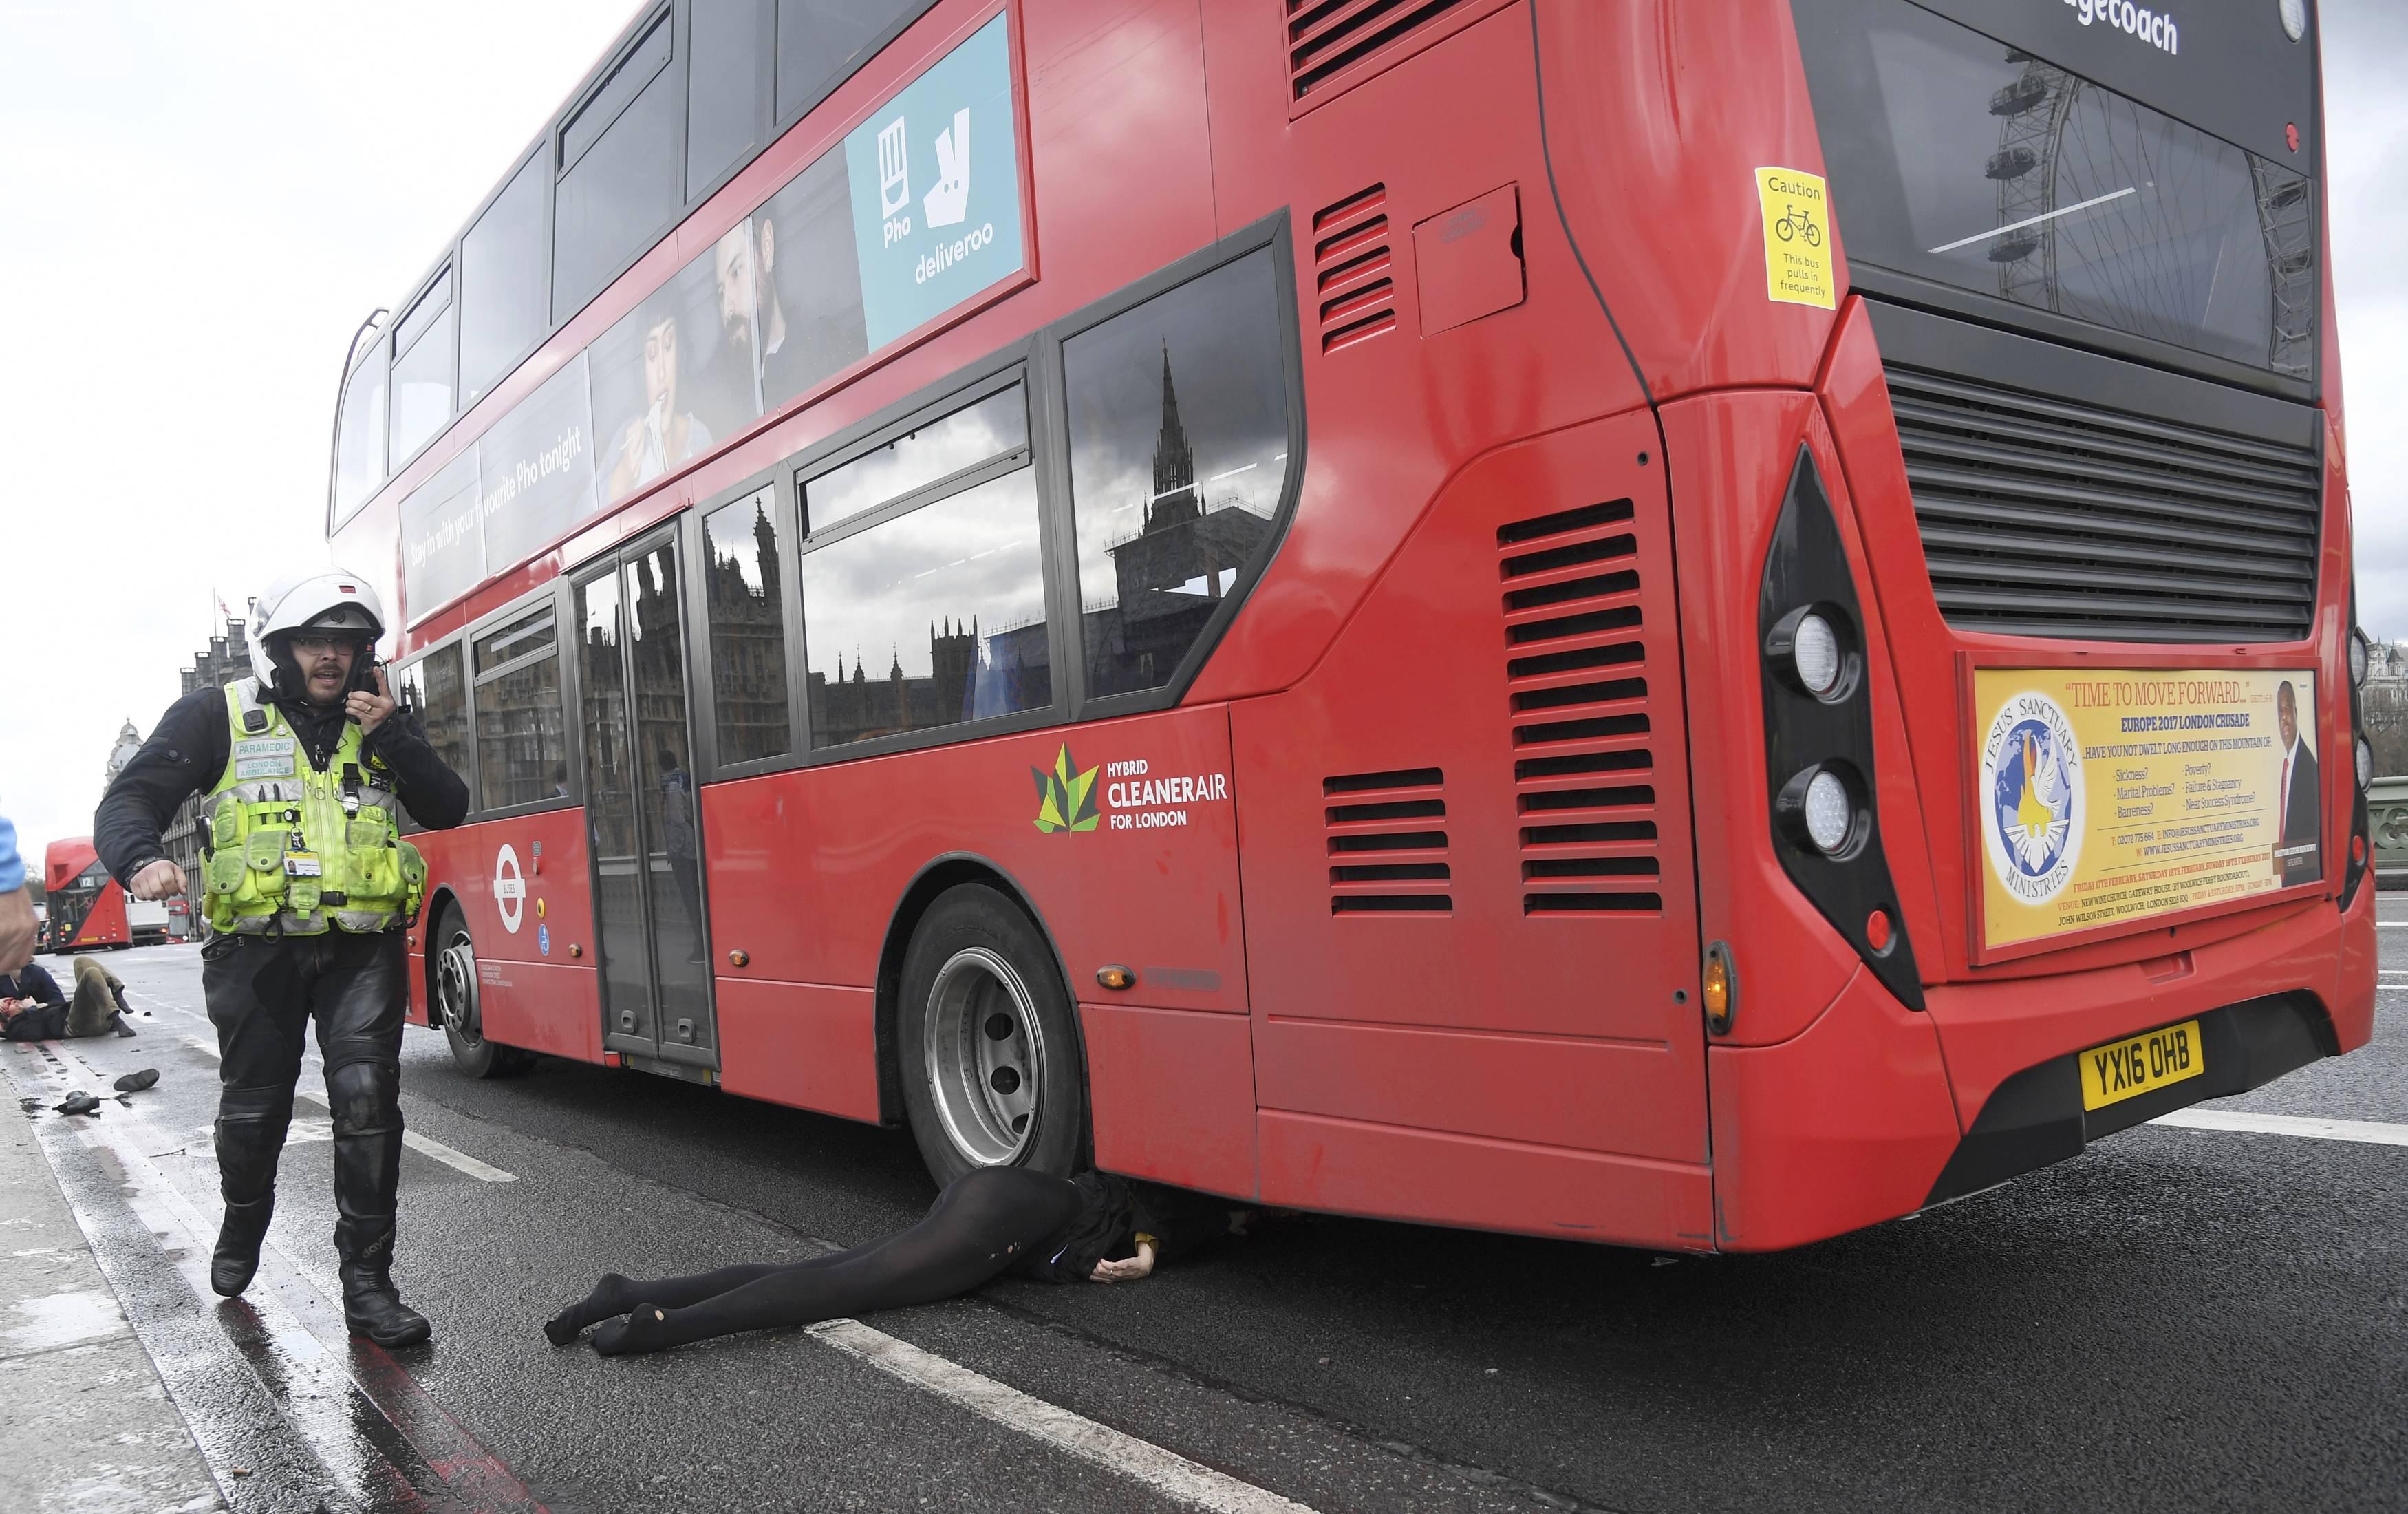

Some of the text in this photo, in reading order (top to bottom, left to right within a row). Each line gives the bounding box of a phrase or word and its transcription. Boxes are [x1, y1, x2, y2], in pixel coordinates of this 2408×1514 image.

[2065, 0, 2178, 55] gecoach
[1768, 177, 1820, 200] Caution
[883, 216, 911, 248] Pho
[915, 222, 993, 284] deliveroo
[1783, 253, 1819, 269] This bus
[1787, 270, 1818, 281] pulls in
[1780, 280, 1825, 299] frequently
[411, 426, 582, 568] Stay in with your favourite Pho tonight
[2114, 682, 2132, 706] TO
[2135, 681, 2176, 706] MOVE
[2121, 713, 2250, 733] EUROPE 2017 LONDON CRUSADE
[1985, 707, 2013, 774] JESUS
[2019, 699, 2077, 771] SANCTUARY
[239, 742, 290, 755] PARAMEDIC
[2107, 745, 2122, 758] YOU
[2123, 744, 2138, 757] NOT
[2139, 743, 2162, 756] DWELT
[2163, 741, 2182, 754] LONG
[2182, 740, 2209, 753] ENOUGH
[2209, 739, 2219, 751] ON
[2219, 738, 2232, 751] THIS
[2233, 736, 2263, 749] MOUNTAIN
[241, 767, 290, 777] AMBULANCE
[247, 760, 281, 769] LONDON
[1107, 759, 1148, 778] HYBRID
[2116, 782, 2175, 800] Marital Problems?
[2185, 778, 2242, 793] Failure & Stagnancy
[2186, 792, 2256, 811] Near Success Syndrome?
[1110, 810, 1187, 830] FOR LONDON
[82, 877, 92, 887] 12
[2006, 860, 2069, 898] MINISTRIES
[2074, 880, 2095, 893] FRIDAY
[2095, 878, 2109, 890] 17TH
[2138, 868, 2168, 882] SATURDAY
[2206, 860, 2225, 871] SUNDAY
[503, 883, 515, 894] BUSES
[2081, 897, 2094, 908] NEW
[2094, 895, 2107, 906] WINE
[2128, 886, 2153, 899] GATEWAY
[2058, 914, 2075, 926] JOHN
[2075, 910, 2097, 924] WILSON
[2147, 897, 2169, 909] LONDON
[2094, 1029, 2190, 1096] YX16 OHB
